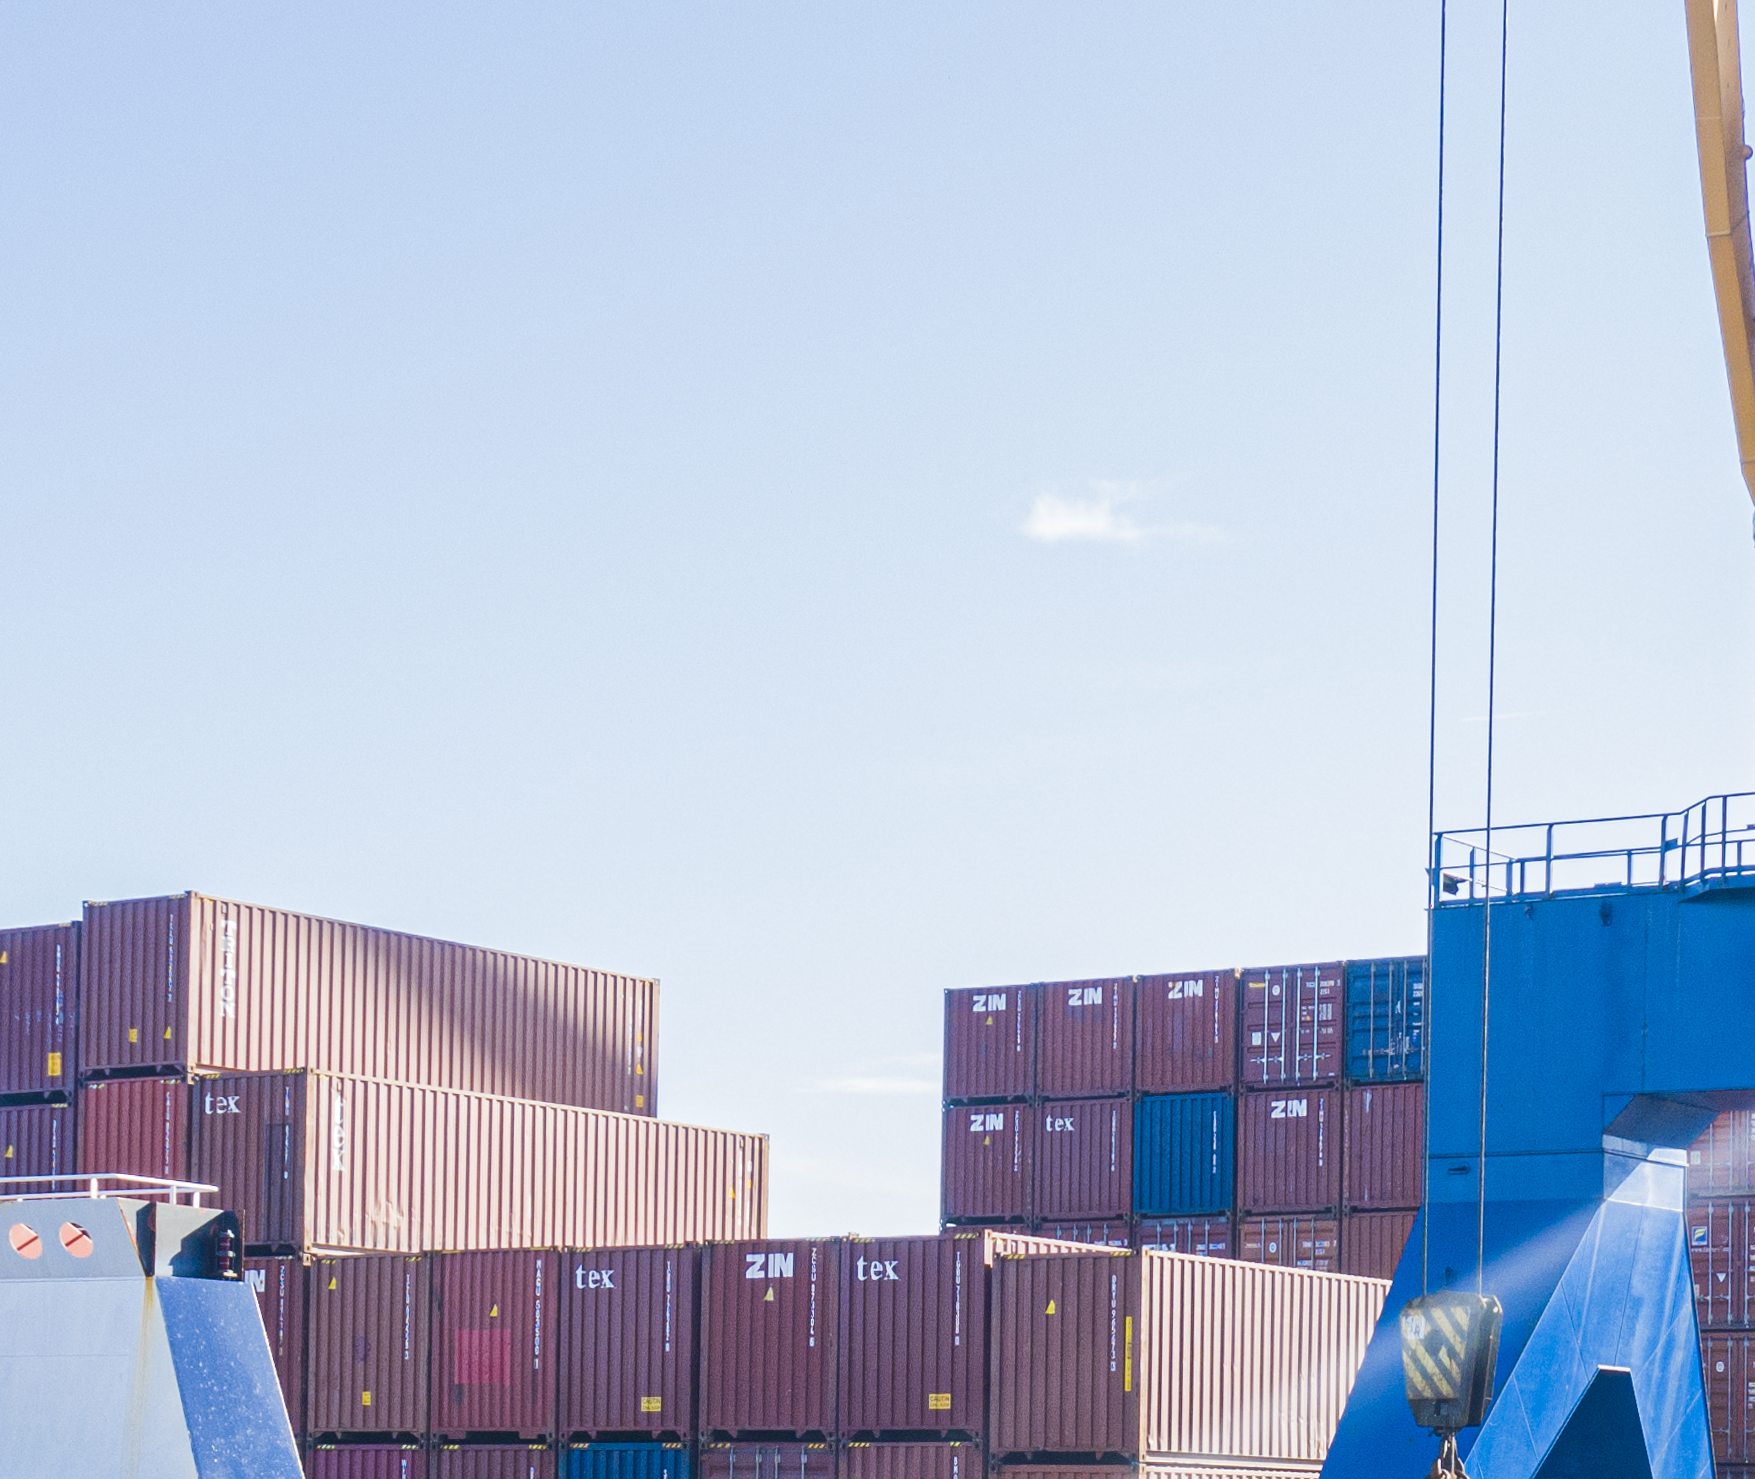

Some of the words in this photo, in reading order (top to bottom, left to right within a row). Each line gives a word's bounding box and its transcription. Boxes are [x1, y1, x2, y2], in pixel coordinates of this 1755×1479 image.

[220, 919, 238, 1019] TRITON
[1068, 987, 1103, 1006] ZIM
[1168, 980, 1204, 1000] ZIM
[972, 993, 1007, 1012] ZIM
[205, 1093, 241, 1115] tex
[1271, 1098, 1308, 1119] ZIM
[331, 1095, 346, 1171] tex
[970, 1113, 1004, 1132] ZIM
[1046, 1115, 1075, 1132] tex
[746, 1253, 794, 1279] ZIM
[857, 1256, 899, 1282] tex
[244, 1269, 265, 1292] IM
[576, 1265, 615, 1290] tex
